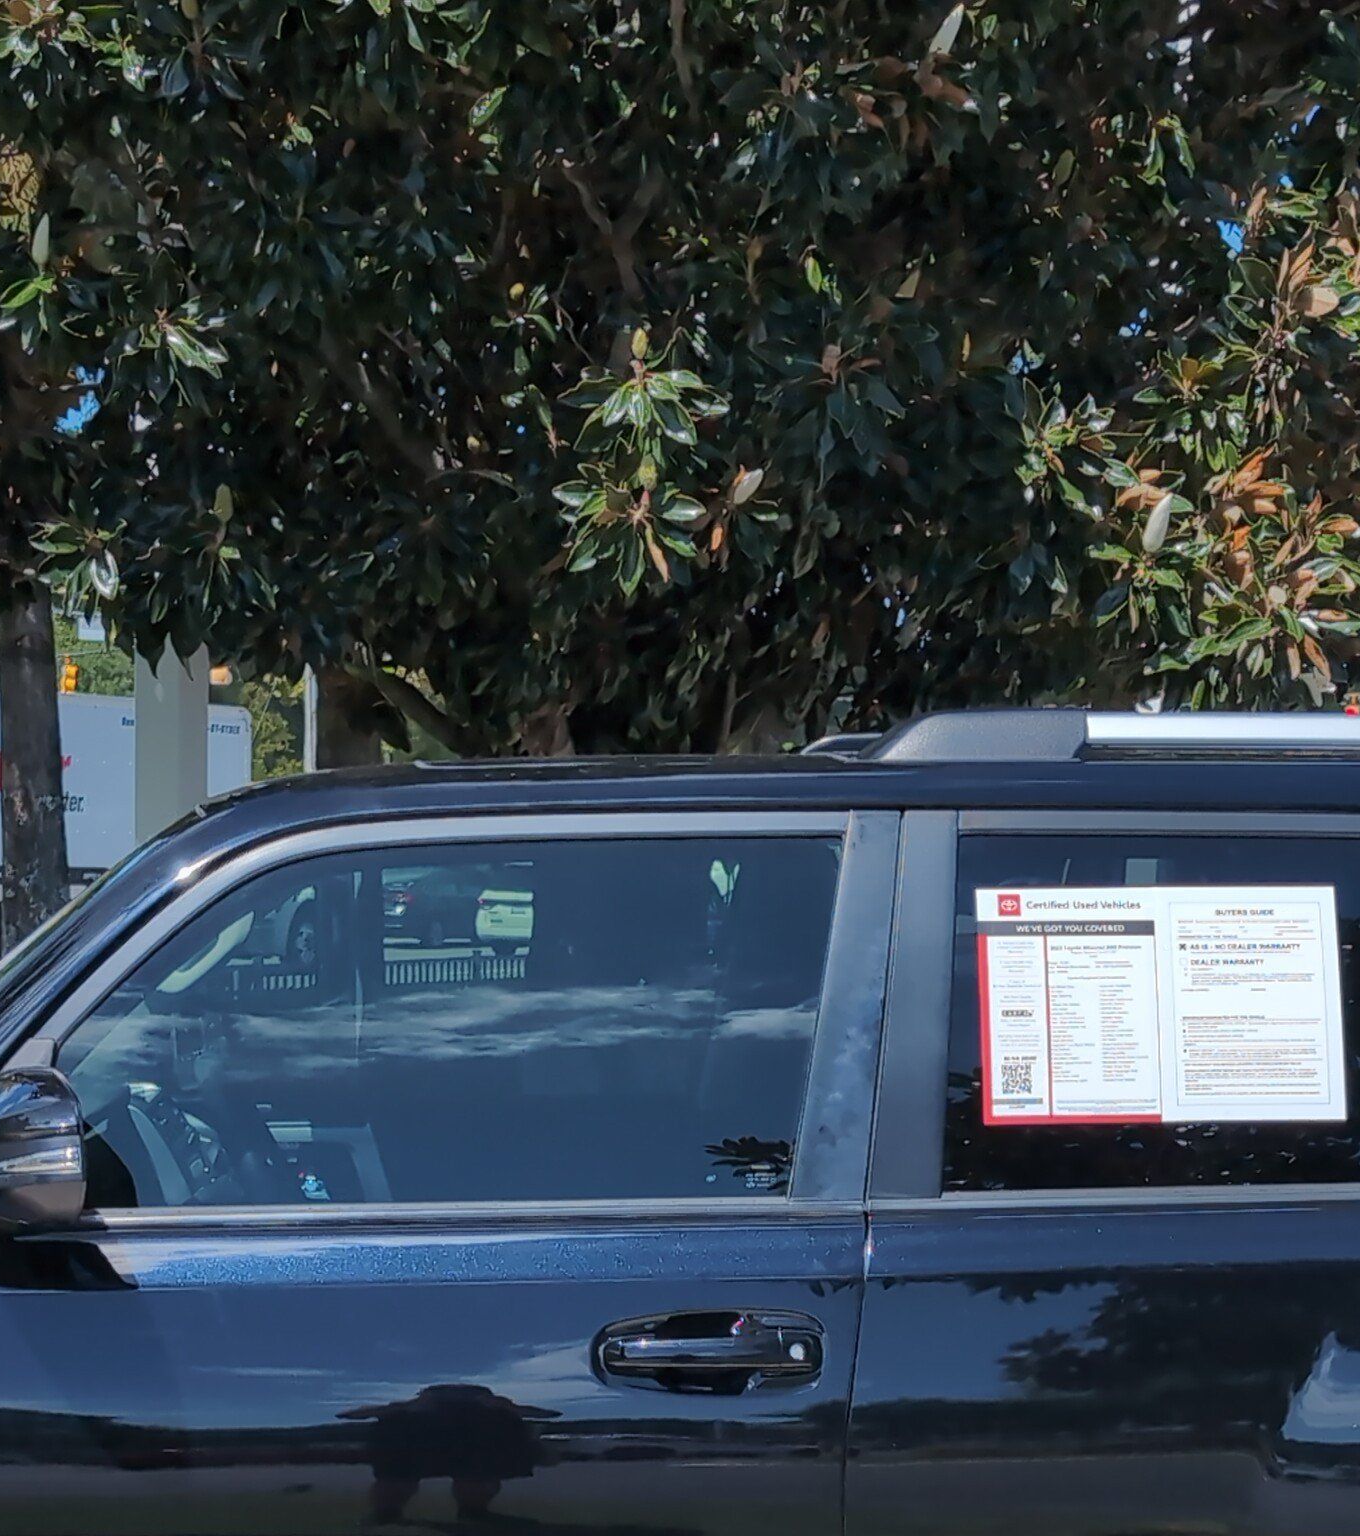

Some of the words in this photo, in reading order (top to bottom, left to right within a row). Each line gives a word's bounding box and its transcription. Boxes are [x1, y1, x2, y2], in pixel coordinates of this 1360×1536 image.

[1026, 900, 1070, 910] Certified
[1073, 900, 1098, 910] Used
[1100, 900, 1141, 910] Vehicles
